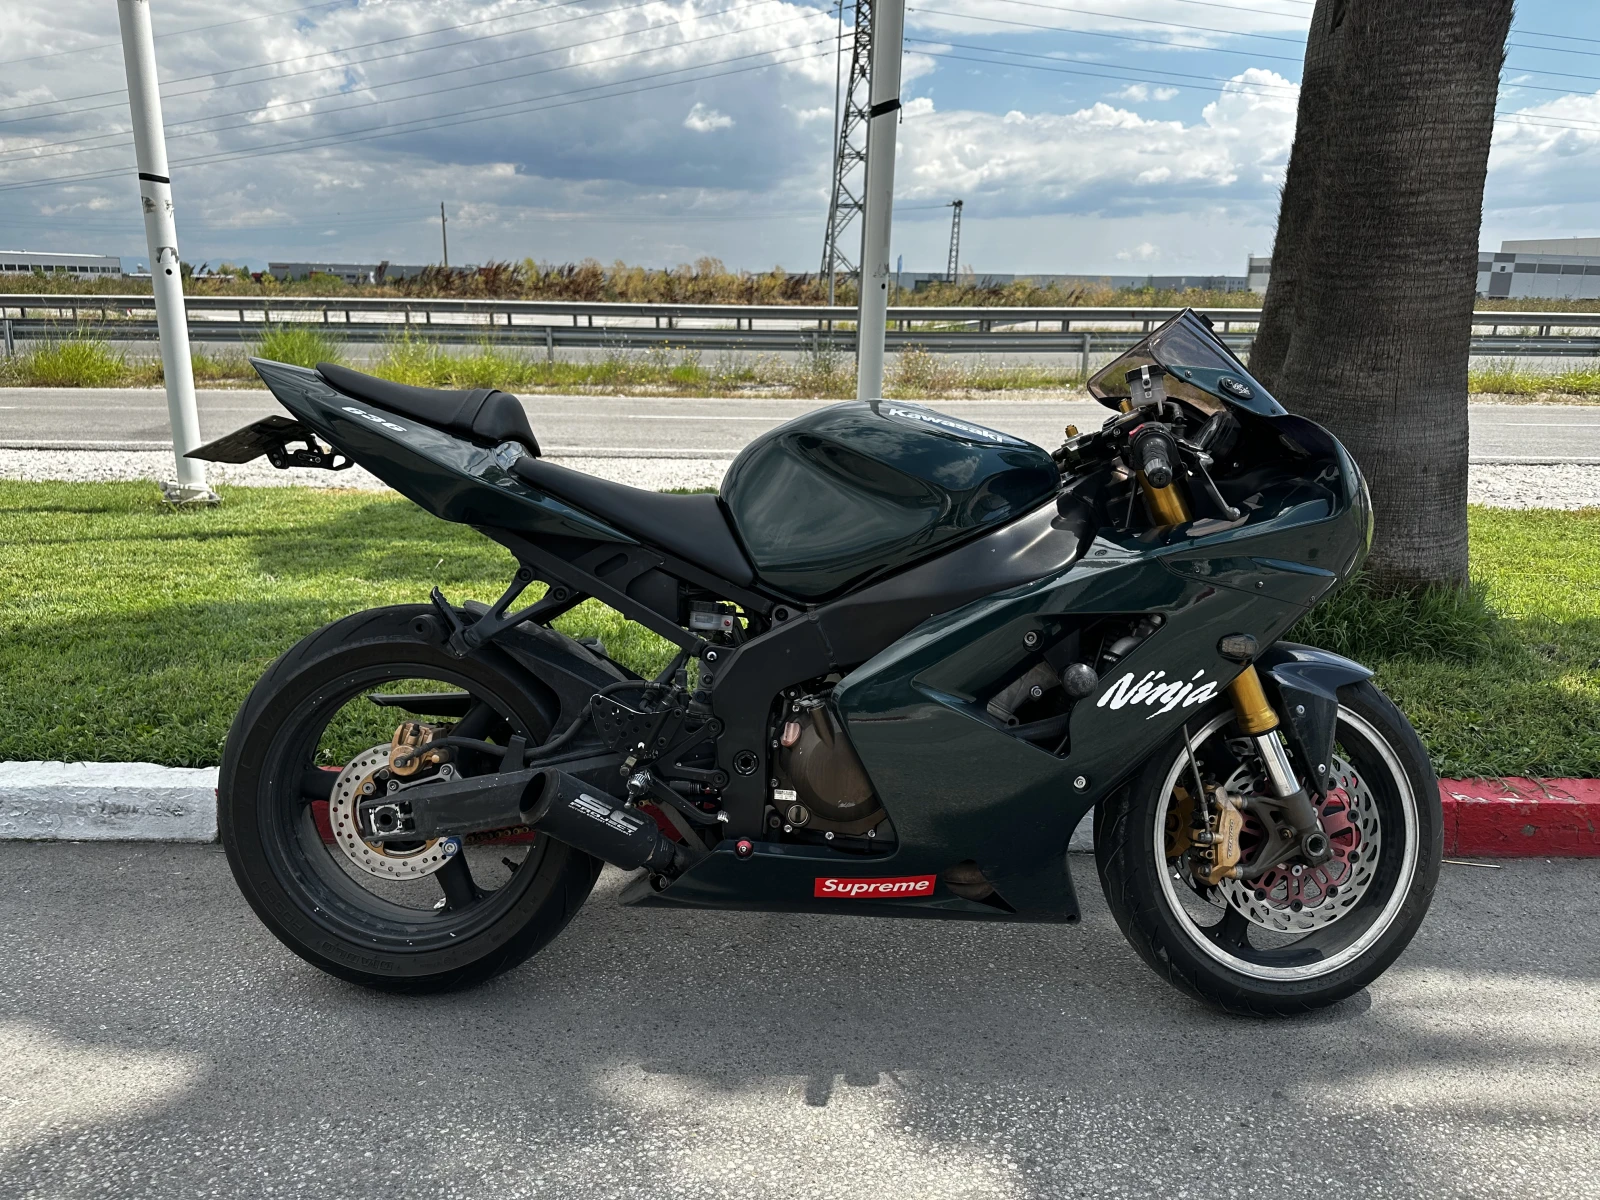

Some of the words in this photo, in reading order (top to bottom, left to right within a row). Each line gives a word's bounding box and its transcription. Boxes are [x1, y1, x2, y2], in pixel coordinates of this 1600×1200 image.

[341, 406, 407, 432] 636
[888, 408, 1003, 443] Kawasaki
[1096, 669, 1218, 720] Ninja
[822, 879, 930, 896] Supreme
